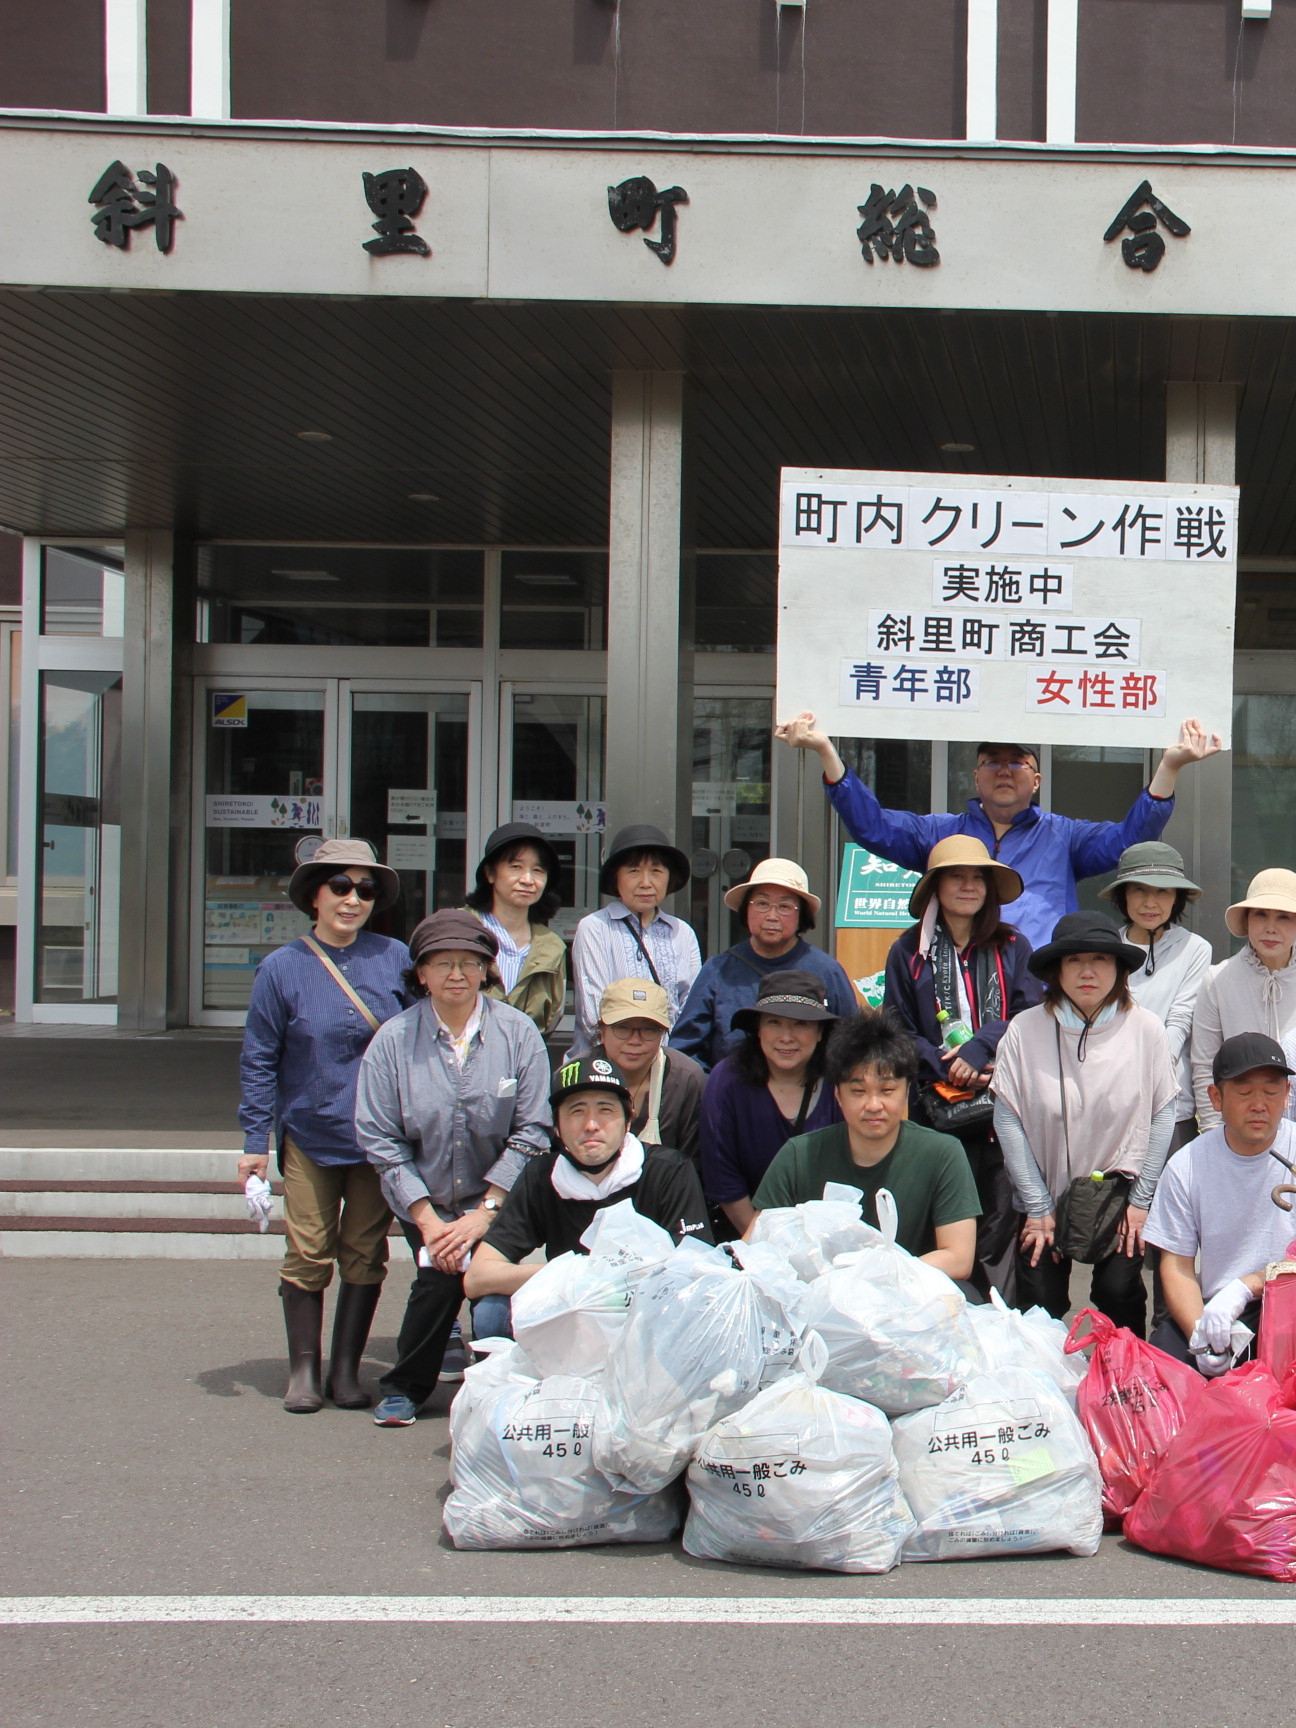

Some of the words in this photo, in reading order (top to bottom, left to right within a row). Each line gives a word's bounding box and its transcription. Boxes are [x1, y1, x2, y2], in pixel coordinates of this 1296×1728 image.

[795, 492, 1228, 559] 町内クリーン作戦
[942, 563, 1064, 606] 実施中
[876, 613, 1131, 660] 斜里町商工会
[849, 662, 972, 703] 青年部
[1036, 669, 1158, 711] 女性部
[854, 897, 910, 910] 世界自然
[589, 1075, 620, 1086] YAMAHA
[928, 1422, 1051, 1454] 公共用一般ごみ
[698, 1456, 807, 1480] 公共用一般ごみ
